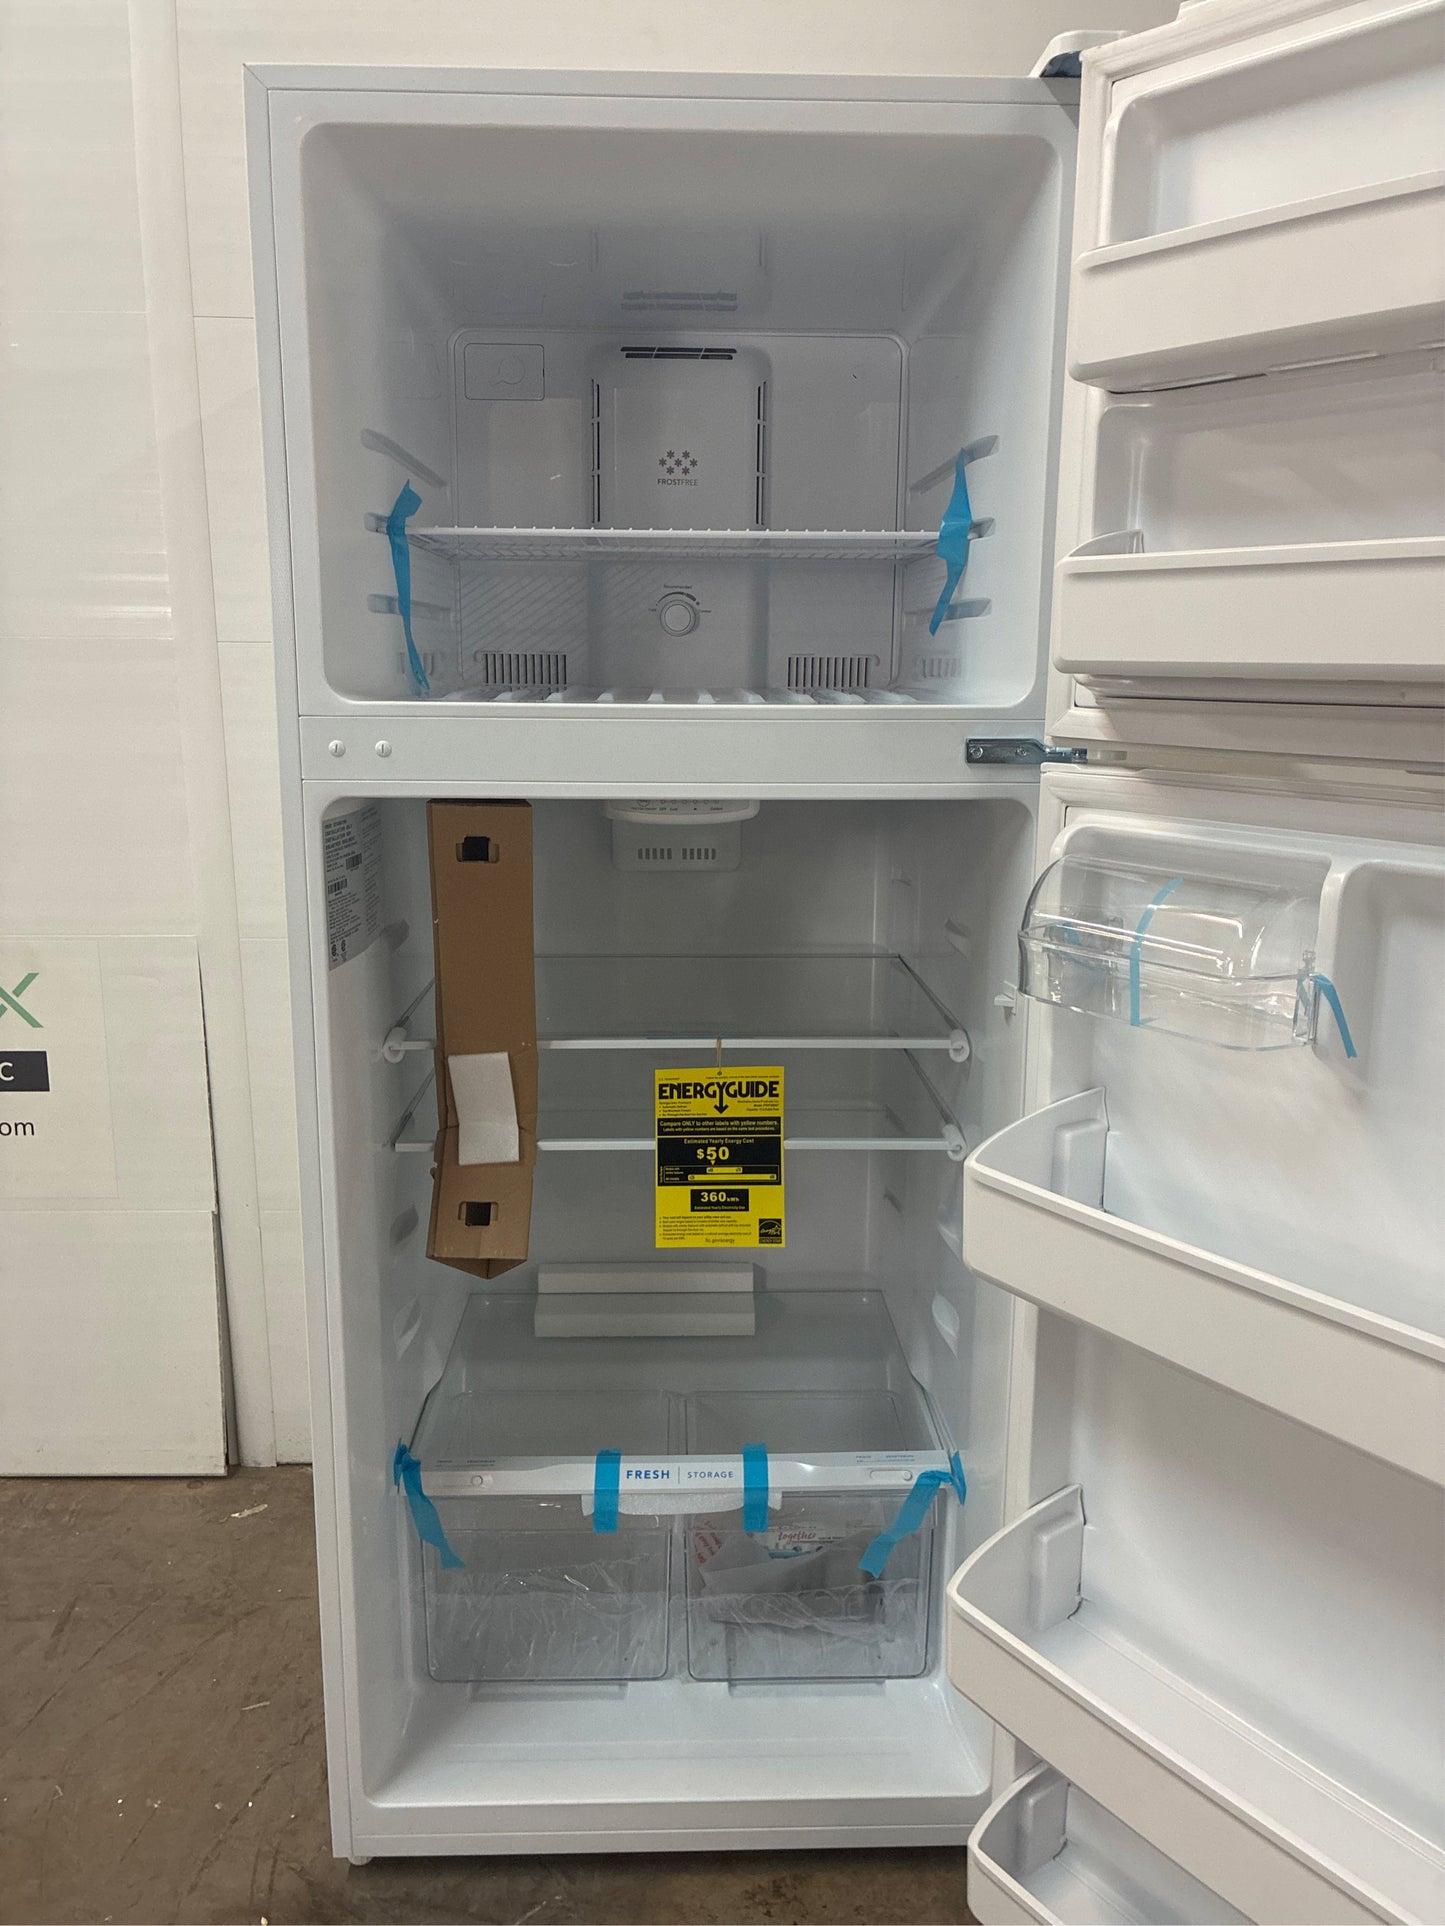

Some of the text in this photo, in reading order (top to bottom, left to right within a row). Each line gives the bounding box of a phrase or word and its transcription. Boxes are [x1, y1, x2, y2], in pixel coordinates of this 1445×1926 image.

[657, 478, 698, 486] FROSTFREE
[658, 1080, 780, 1100] ENERGYGUIDE
[696, 1146, 729, 1160] $50
[700, 1192, 726, 1202] 360
[626, 1470, 670, 1480] FRESH
[778, 1532, 816, 1544] together
